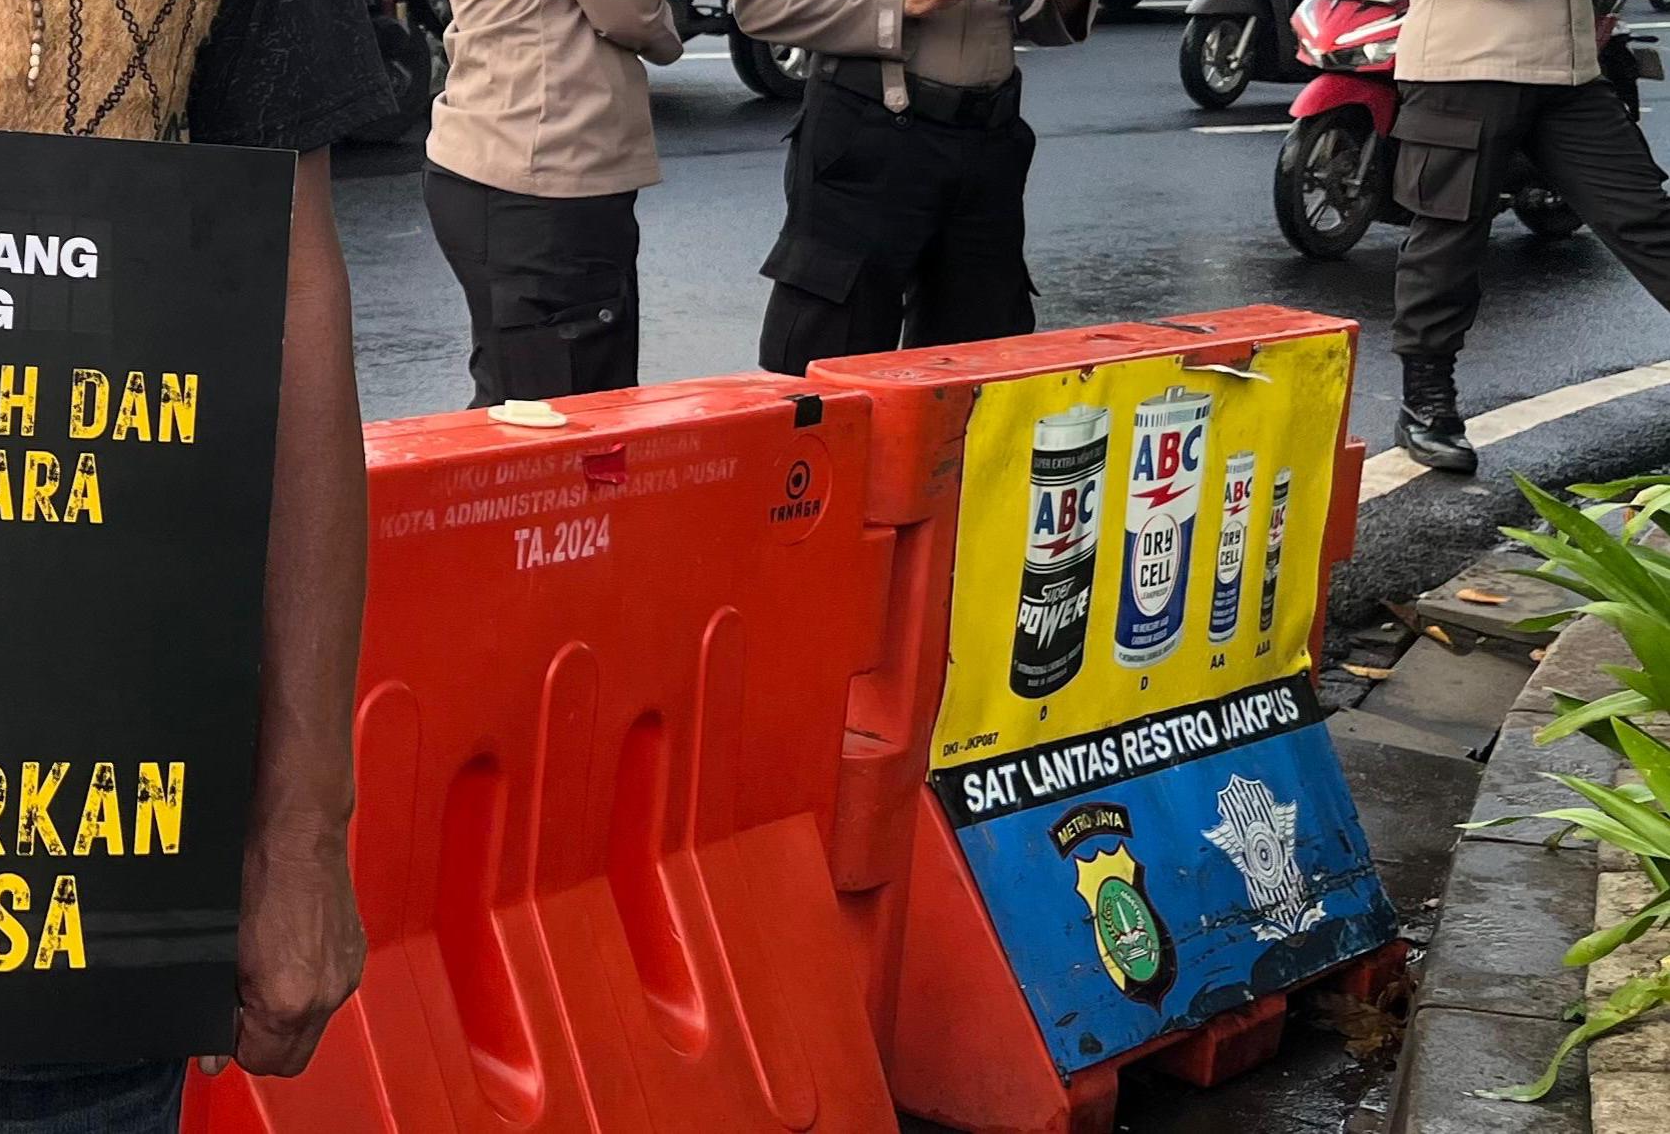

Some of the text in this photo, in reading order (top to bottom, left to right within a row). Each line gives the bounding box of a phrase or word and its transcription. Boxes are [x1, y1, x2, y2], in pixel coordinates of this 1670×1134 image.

[68, 368, 199, 445] DAN
[1133, 424, 1203, 481] ABC
[378, 507, 435, 540] KOTA
[443, 483, 588, 530] ADMINISTRASI
[683, 456, 738, 484] PUSAT
[433, 463, 490, 498] UKU
[1224, 476, 1252, 503] ABC
[770, 499, 821, 523] TANAGA
[1034, 479, 1096, 535] ABC
[514, 514, 610, 570] TA.2024
[1143, 527, 1174, 556] DRY
[1220, 548, 1239, 566] CELL
[1140, 559, 1171, 588] CELL
[1017, 585, 1090, 650] POWER
[1210, 653, 1225, 670] AA
[963, 686, 1300, 813] SAT LANTAS RESTRO JAKPUS
[1057, 810, 1125, 847] METRO JAYA
